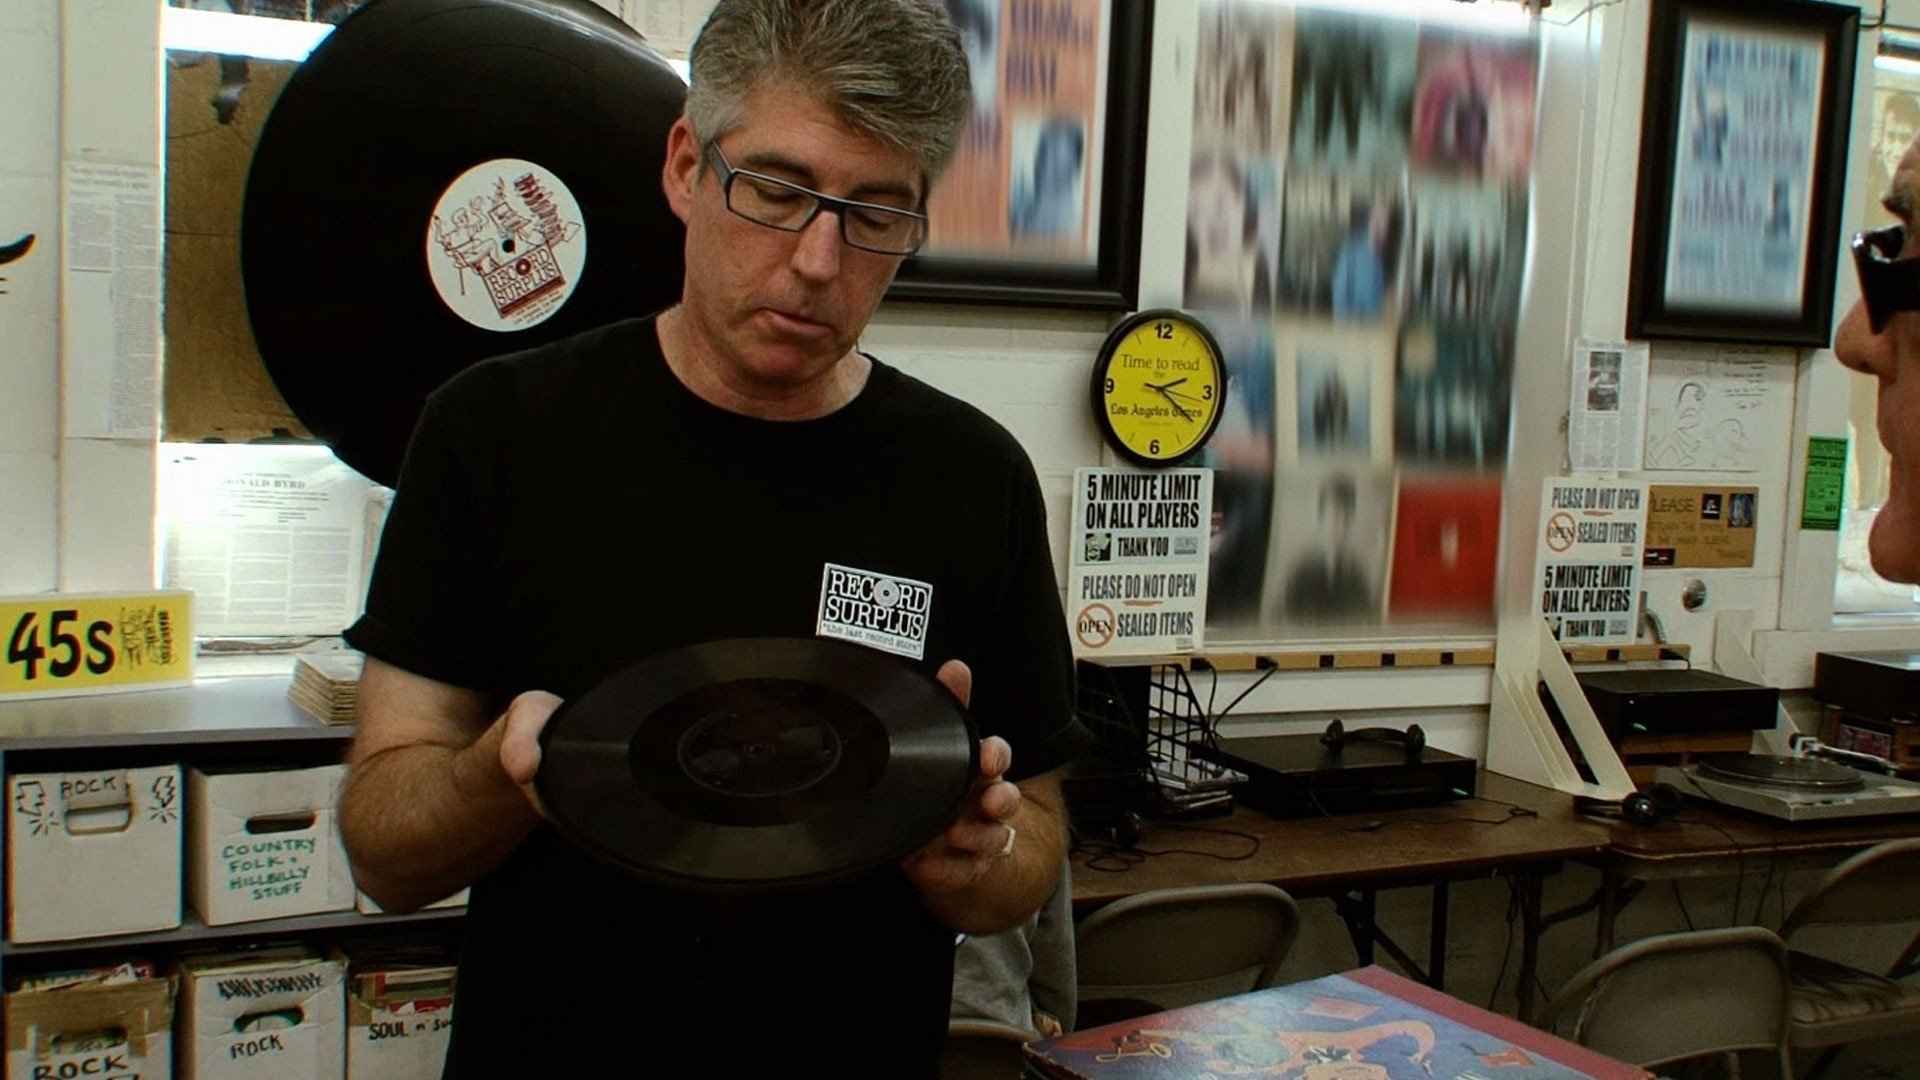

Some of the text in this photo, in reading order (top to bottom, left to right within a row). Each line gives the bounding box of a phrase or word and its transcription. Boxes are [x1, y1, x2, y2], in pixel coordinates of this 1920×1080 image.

[489, 249, 549, 291] RECORD
[495, 262, 557, 306] SURPLUS
[1154, 323, 1173, 339] 12
[1122, 354, 1200, 371] Time to read
[1105, 378, 1115, 394] 9
[1202, 385, 1213, 400] 3
[1111, 403, 1128, 415] Los
[1131, 403, 1170, 418] Angeles
[1149, 439, 1160, 454] 6
[274, 479, 305, 489] BYRD
[1087, 474, 1201, 501] 5 MINUTE LIMIT
[1552, 487, 1640, 510] PLEASE DO NOT OPEN
[1085, 502, 1200, 529] ON ALL PLAYERS
[1549, 526, 1574, 539] OPEN
[1577, 522, 1609, 543] SEALED
[1609, 522, 1637, 543] ITEMS
[1117, 537, 1149, 557] THANK
[1150, 537, 1169, 557] YOU
[1082, 573, 1197, 600] PLEASE DO NOT OPEN
[1545, 565, 1633, 589] 5 MINUTE LIMIT
[828, 569, 928, 613] RECORD
[1543, 589, 1630, 613] ON ALL PLAYERS
[825, 595, 924, 640] SURPLUS
[1078, 619, 1112, 634] OPEN
[1117, 611, 1193, 637] SEALED ITEMS
[844, 627, 863, 639] last
[865, 632, 894, 645] record
[1565, 620, 1590, 638] THANK
[1590, 619, 1605, 637] YOU
[8, 609, 115, 680] 45s
[60, 777, 117, 798] ROCK
[221, 837, 316, 859] COUNTRY
[228, 856, 283, 873] FOLK
[229, 866, 310, 891] HILLBILLY
[251, 884, 303, 900] STUFF
[369, 1021, 408, 1040] SOUL
[230, 1034, 283, 1059] ROCK
[33, 1054, 129, 1080] ROCK
